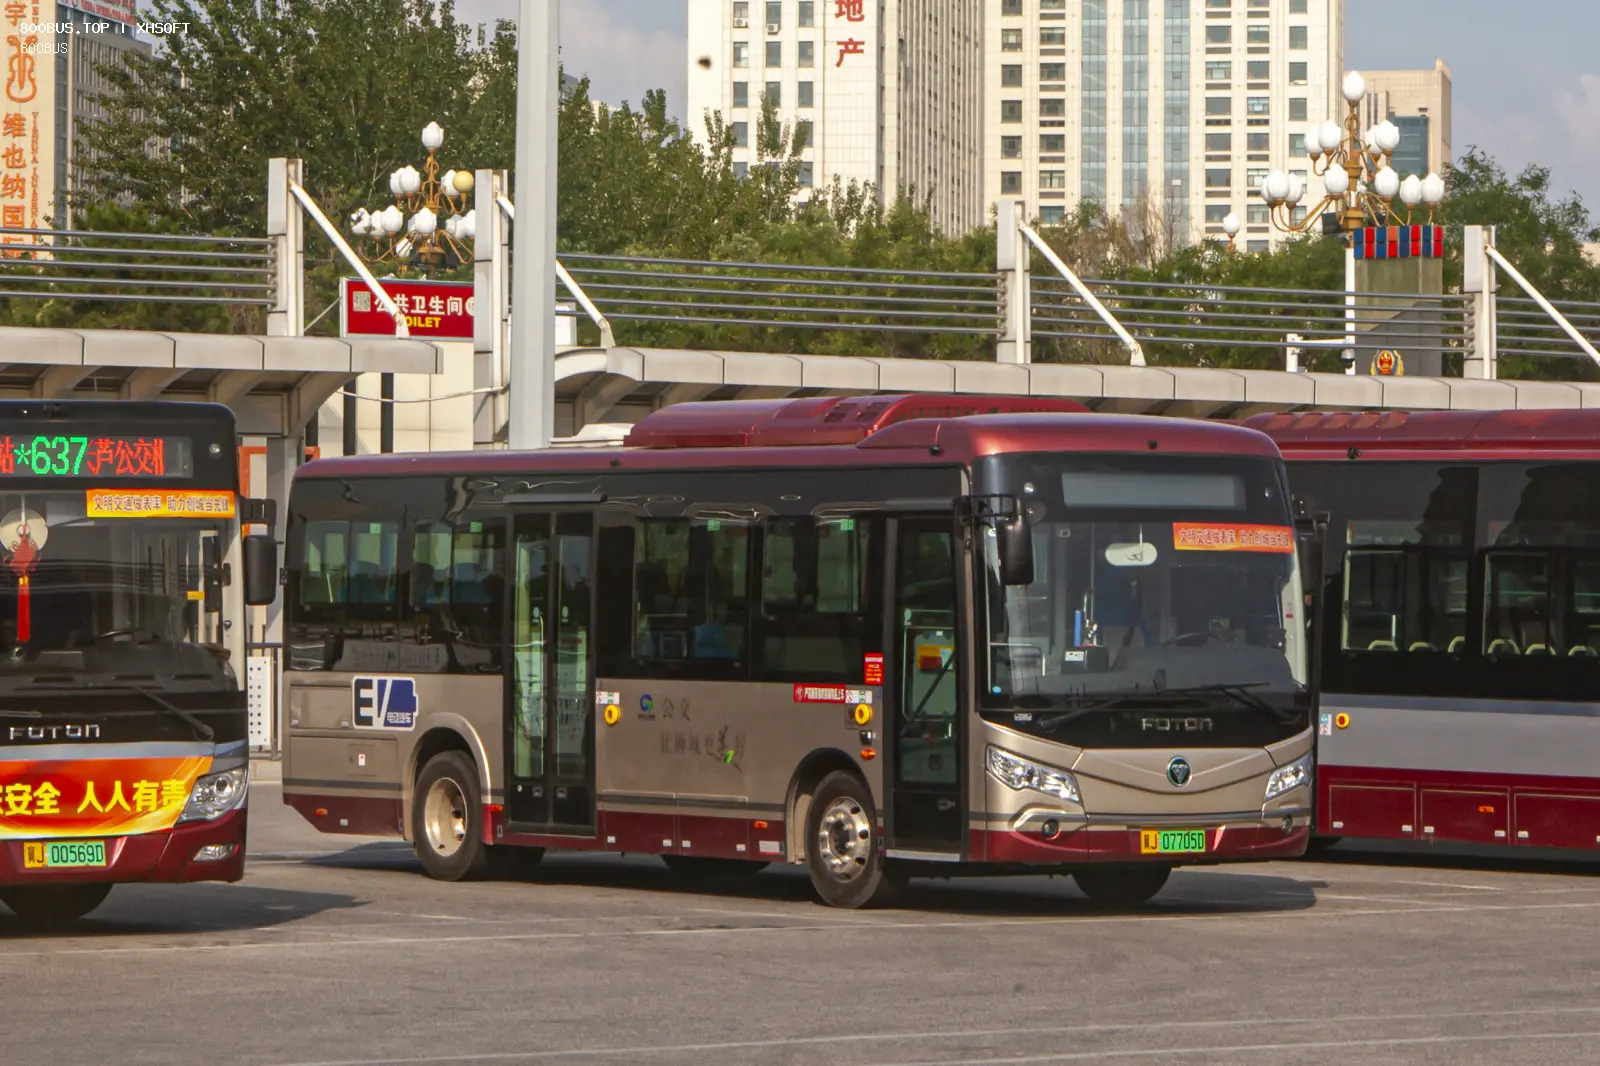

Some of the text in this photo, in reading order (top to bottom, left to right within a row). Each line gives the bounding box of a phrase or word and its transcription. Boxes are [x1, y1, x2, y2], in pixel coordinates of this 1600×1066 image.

[835, 0, 865, 67] 地产
[404, 315, 441, 328] OILET
[9, 723, 100, 740] FOTON
[1141, 717, 1213, 731] FOTON
[0, 778, 188, 816] 安全 人人有责
[1162, 832, 1205, 850] 07705D
[51, 844, 104, 863] 00569D
